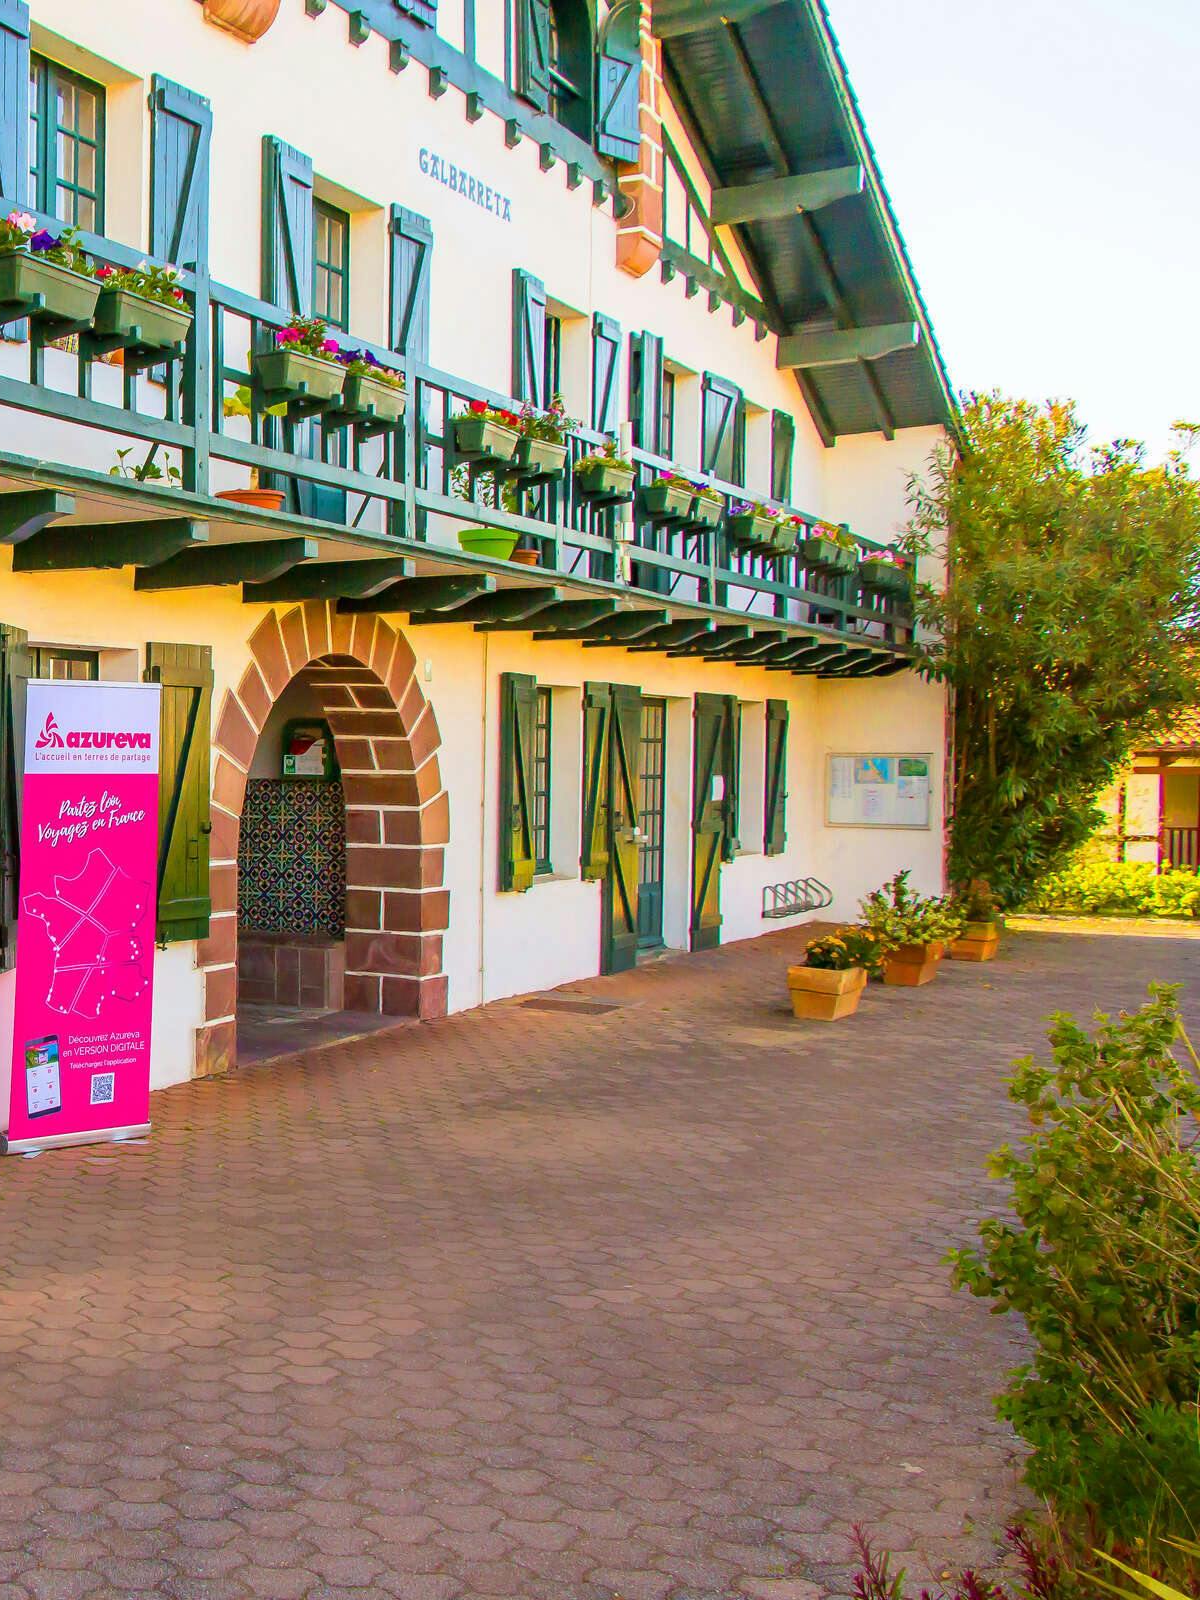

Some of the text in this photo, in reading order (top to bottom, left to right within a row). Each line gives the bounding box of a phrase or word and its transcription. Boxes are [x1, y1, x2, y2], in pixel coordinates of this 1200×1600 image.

[419, 147, 512, 222] GALBARRETA
[66, 732, 151, 748] azureva
[35, 752, 70, 761] L'accueil
[84, 753, 108, 761] terres
[110, 753, 119, 761] de
[121, 753, 151, 763] partage
[58, 795, 98, 819] Partez
[38, 808, 145, 847] Voyagez en France
[109, 1032, 140, 1041] Azureva
[73, 1045, 109, 1056] VERSION
[110, 1041, 145, 1053] DIGITALE
